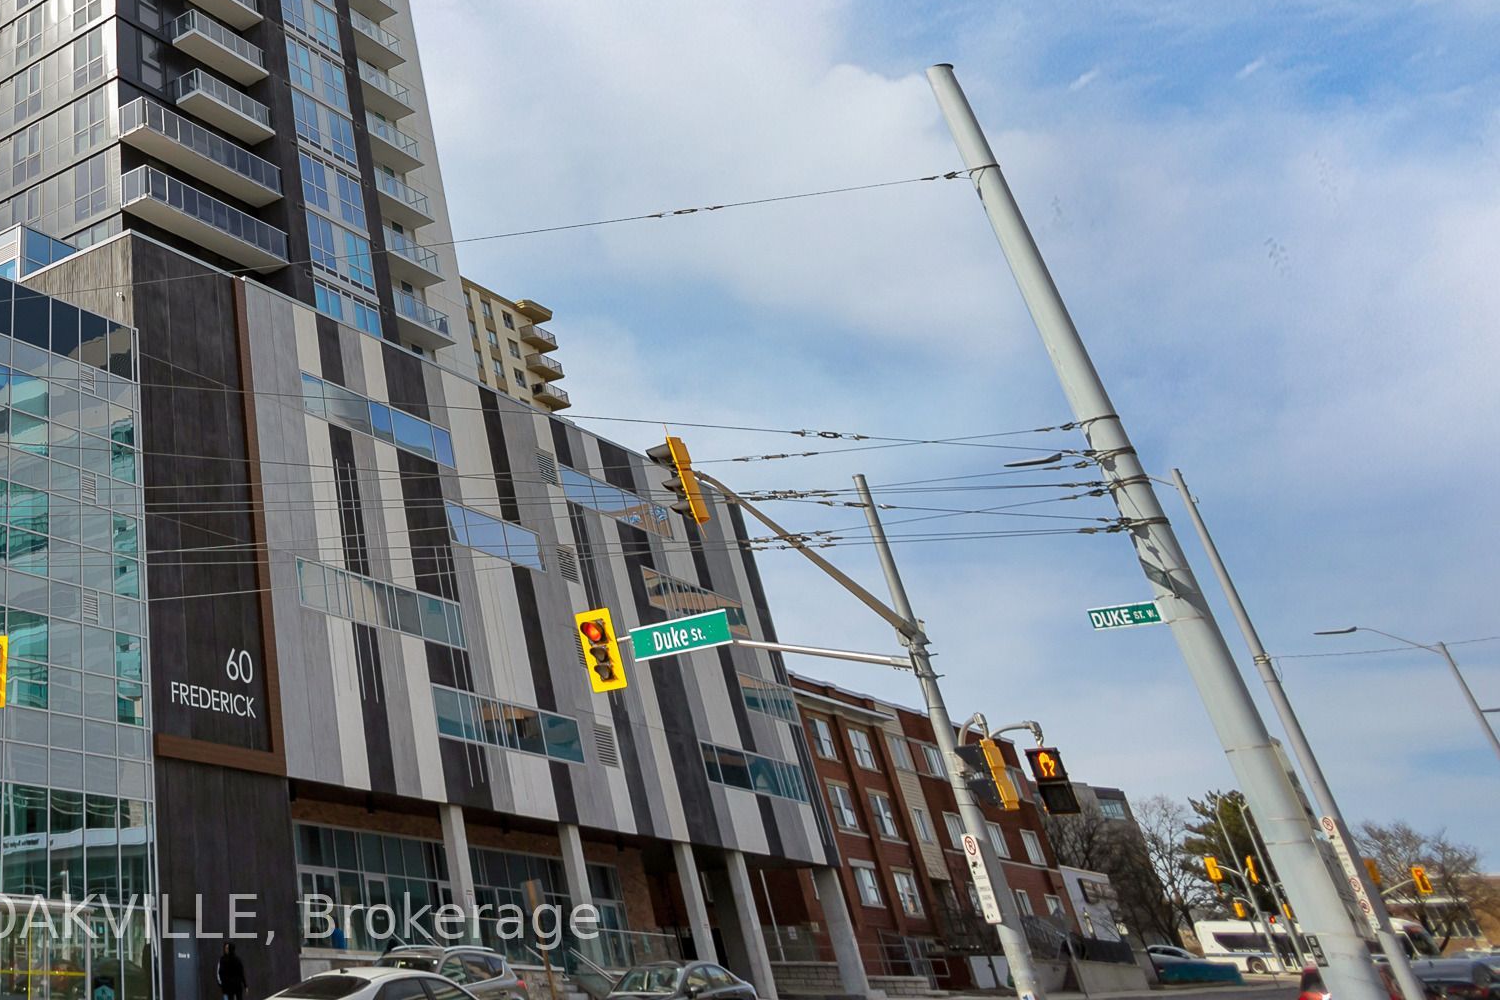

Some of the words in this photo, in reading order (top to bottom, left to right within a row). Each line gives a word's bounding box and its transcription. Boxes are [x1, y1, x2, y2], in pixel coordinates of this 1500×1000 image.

[1091, 609, 1133, 628] DUKE
[1133, 611, 1145, 620] ST.
[1146, 609, 1158, 618] W.
[652, 627, 689, 652] Duke
[691, 628, 706, 642] St.
[226, 648, 253, 684] 60
[171, 681, 256, 719] FREDERICK
